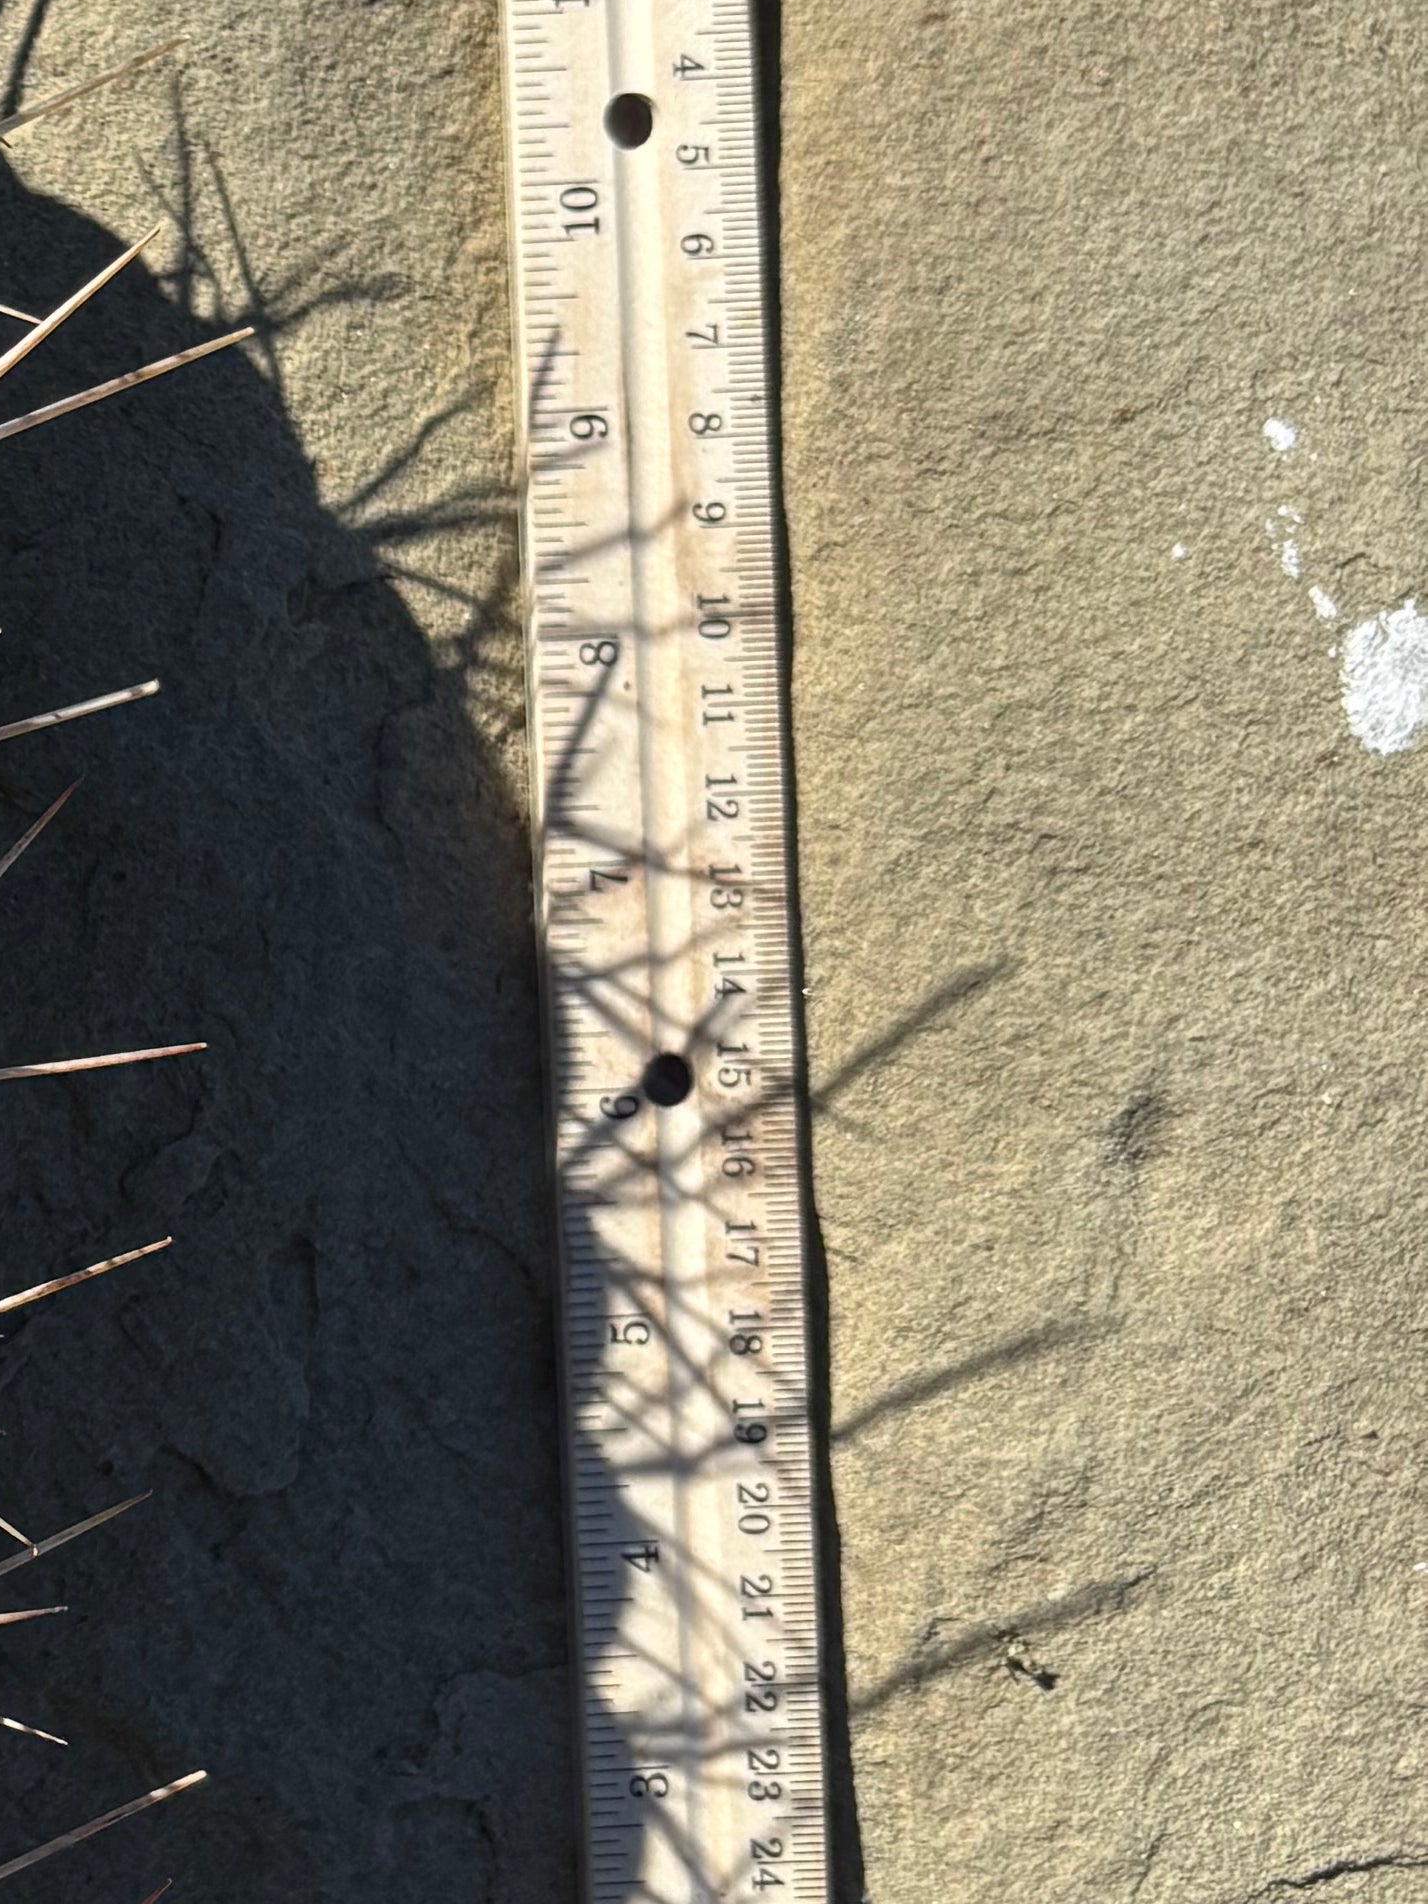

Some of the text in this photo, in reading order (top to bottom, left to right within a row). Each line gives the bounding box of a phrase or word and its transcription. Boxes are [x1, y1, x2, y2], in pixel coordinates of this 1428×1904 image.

[673, 54, 705, 78] 4
[675, 144, 711, 164] 5
[560, 186, 601, 237] 10
[680, 232, 715, 257] 6
[685, 323, 719, 345] 7
[569, 413, 609, 440] 9
[688, 412, 723, 435] 8
[692, 501, 726, 524] 9
[697, 593, 732, 640] 10
[578, 641, 618, 667] 8
[701, 683, 735, 726] 11
[705, 773, 739, 822] 12
[589, 869, 629, 893] 7
[708, 863, 744, 909] 13
[713, 951, 747, 999] 14
[716, 1041, 753, 1088] 15
[599, 1095, 640, 1121] 6
[720, 1130, 757, 1179] 16
[724, 1220, 760, 1267] 17
[610, 1322, 651, 1347] 5
[728, 1308, 764, 1356] 18
[731, 1398, 768, 1445] 19
[737, 1482, 772, 1535] 20
[621, 1544, 661, 1573] 4
[740, 1574, 774, 1621] 21
[743, 1660, 777, 1713] 22
[628, 1771, 669, 1799] 3
[747, 1749, 783, 1802] 23
[750, 1836, 784, 1892] 24
